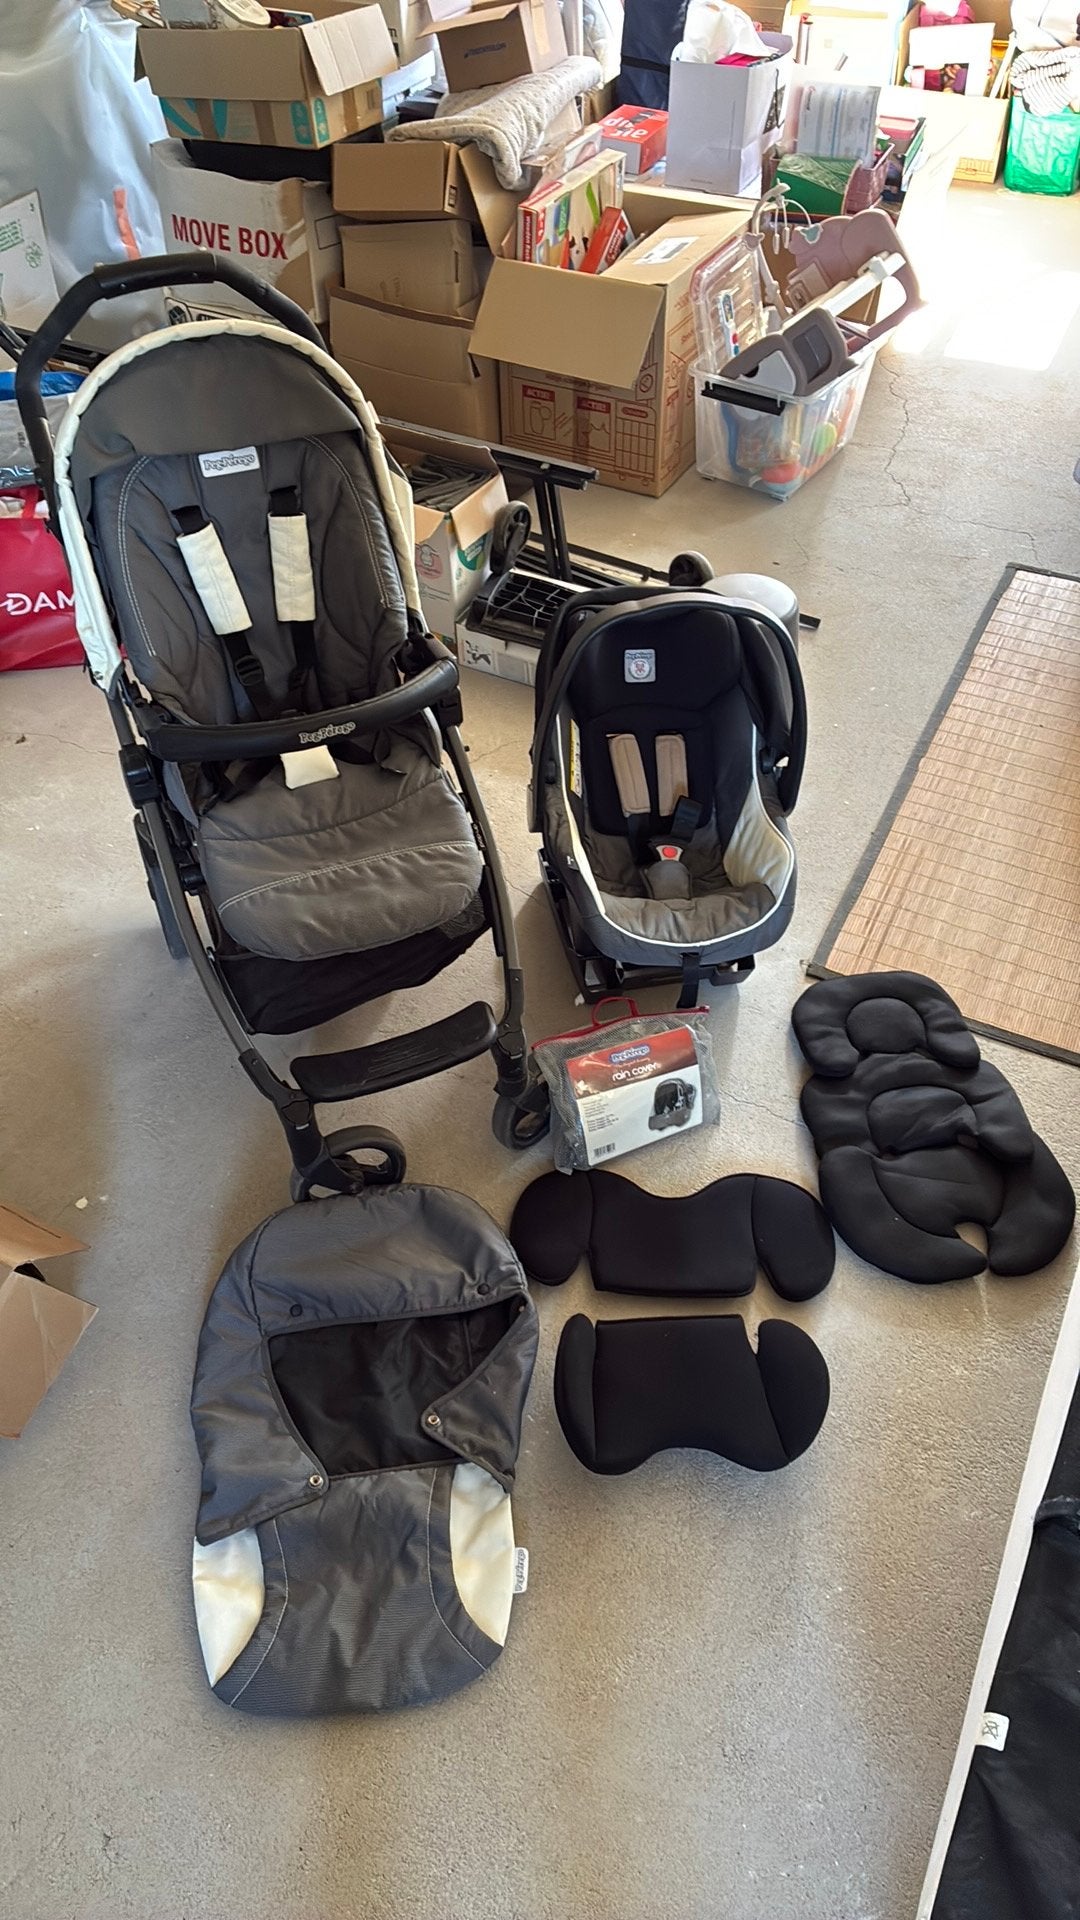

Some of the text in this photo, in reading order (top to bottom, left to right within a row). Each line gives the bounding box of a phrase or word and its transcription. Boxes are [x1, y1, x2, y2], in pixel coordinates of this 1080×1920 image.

[171, 214, 289, 260] MOVE BOX
[612, 1070, 631, 1081] rain
[631, 1062, 658, 1077] cover
